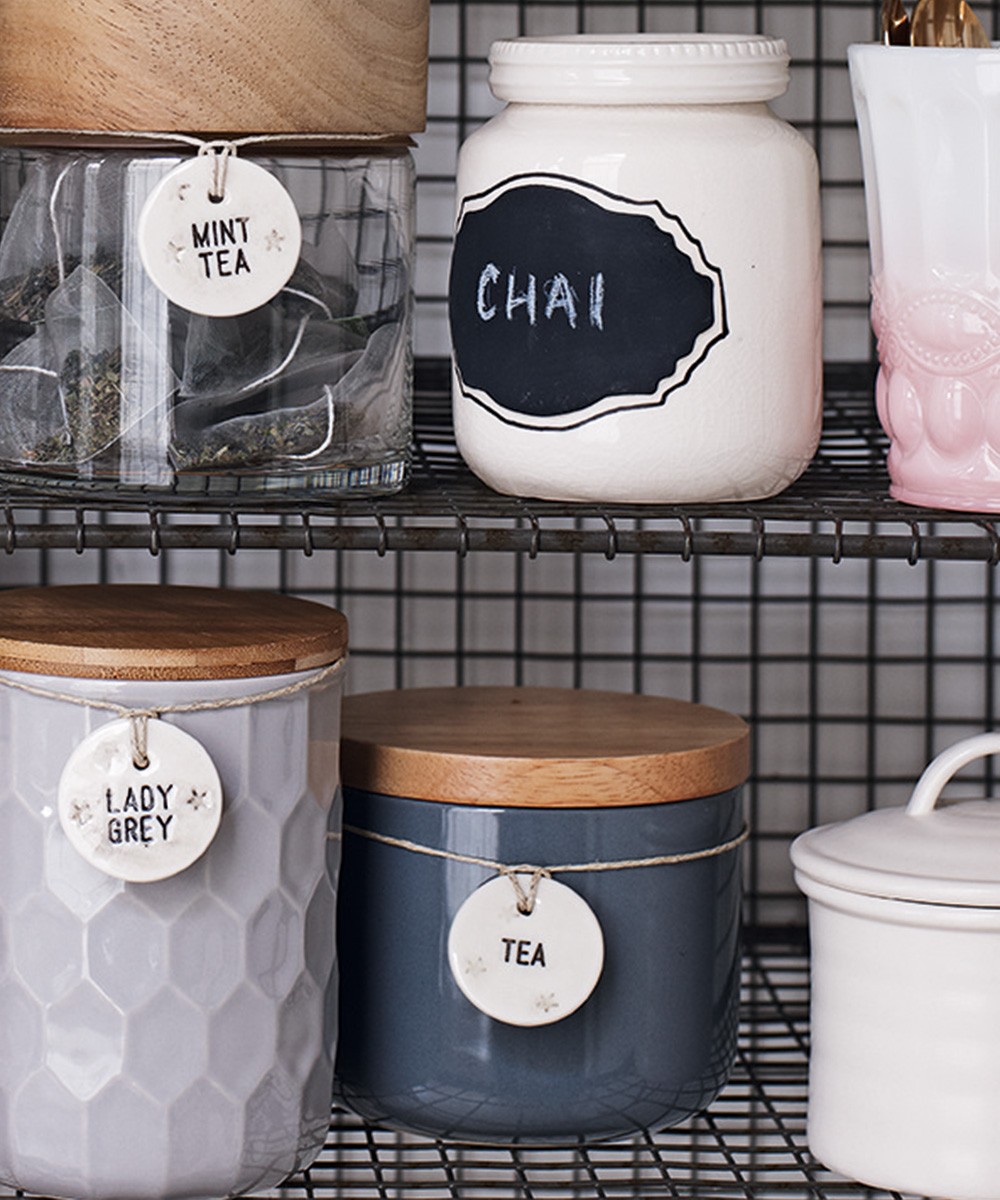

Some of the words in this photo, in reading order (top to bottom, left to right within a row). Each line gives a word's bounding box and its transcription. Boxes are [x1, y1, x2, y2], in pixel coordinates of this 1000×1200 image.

[191, 216, 250, 248] MINT
[198, 248, 251, 279] TEA
[476, 262, 604, 331] CHAI
[105, 784, 173, 814] LADY
[107, 814, 173, 844] GREY
[501, 937, 546, 968] TEA
